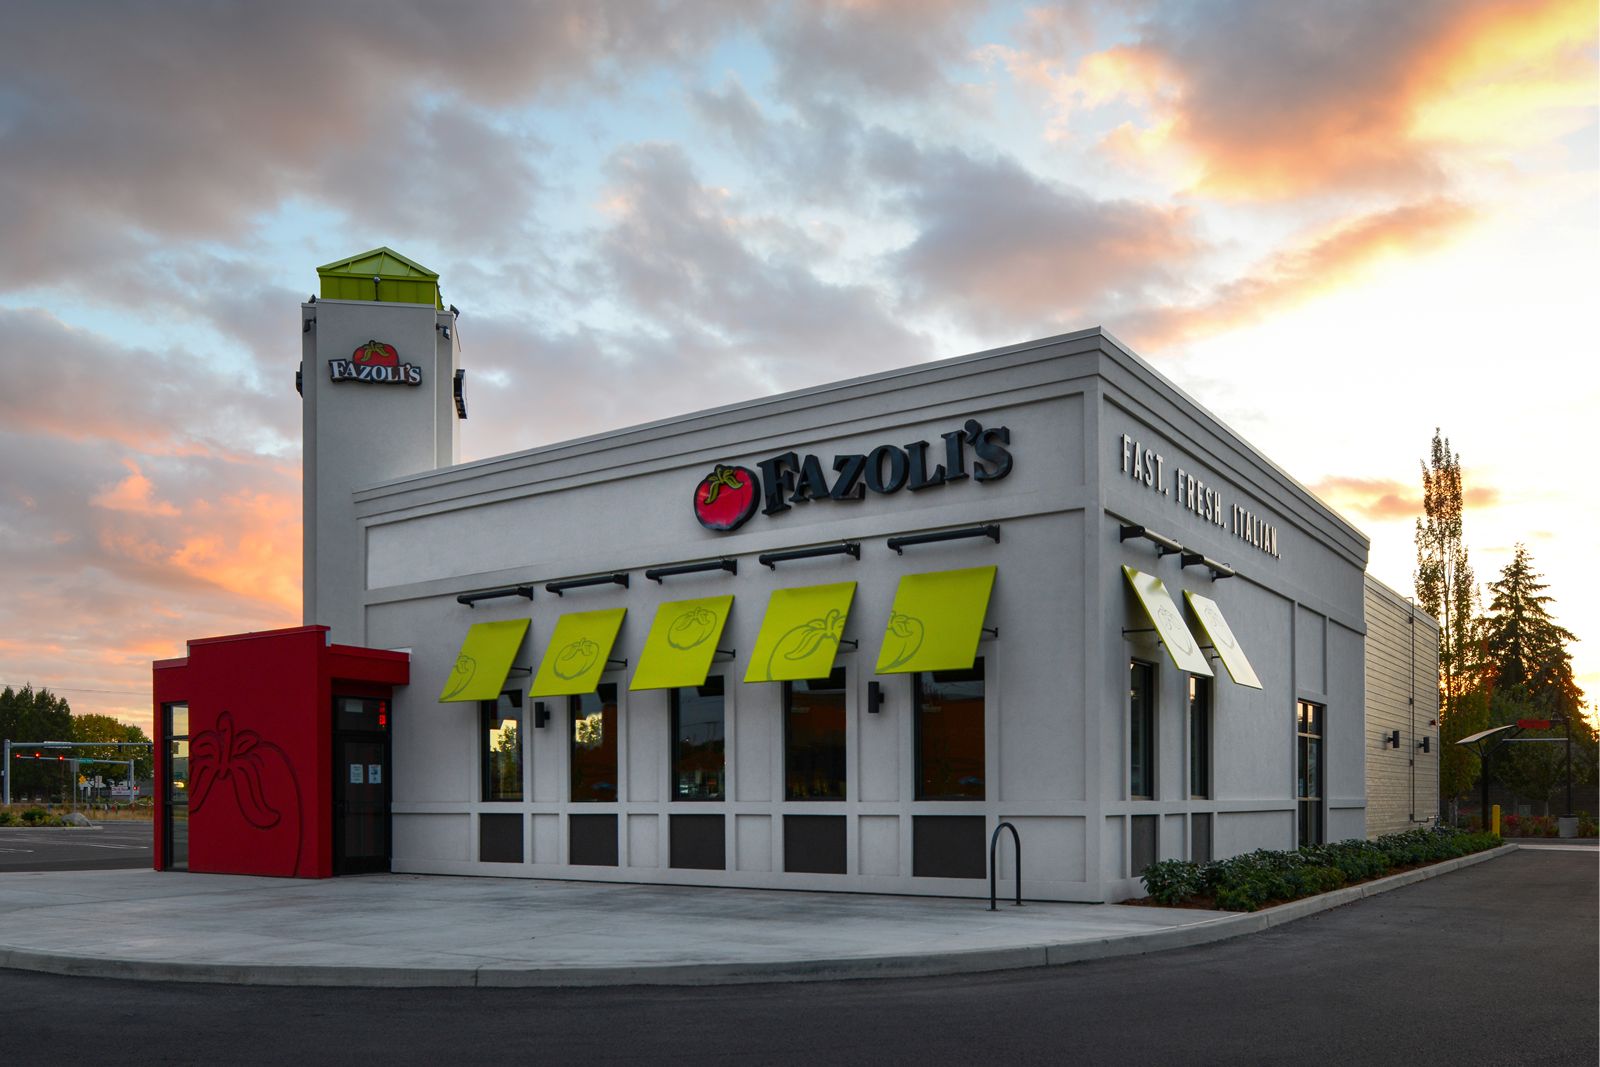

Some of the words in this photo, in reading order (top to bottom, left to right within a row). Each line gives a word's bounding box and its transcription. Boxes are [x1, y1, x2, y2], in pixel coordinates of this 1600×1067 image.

[330, 360, 421, 384] FAZOLI'S
[756, 418, 1014, 516] FAZOLI'S
[1121, 433, 1169, 496] FAST.
[1176, 468, 1227, 529] FRESH.
[1232, 503, 1281, 559] ITALIAN.
